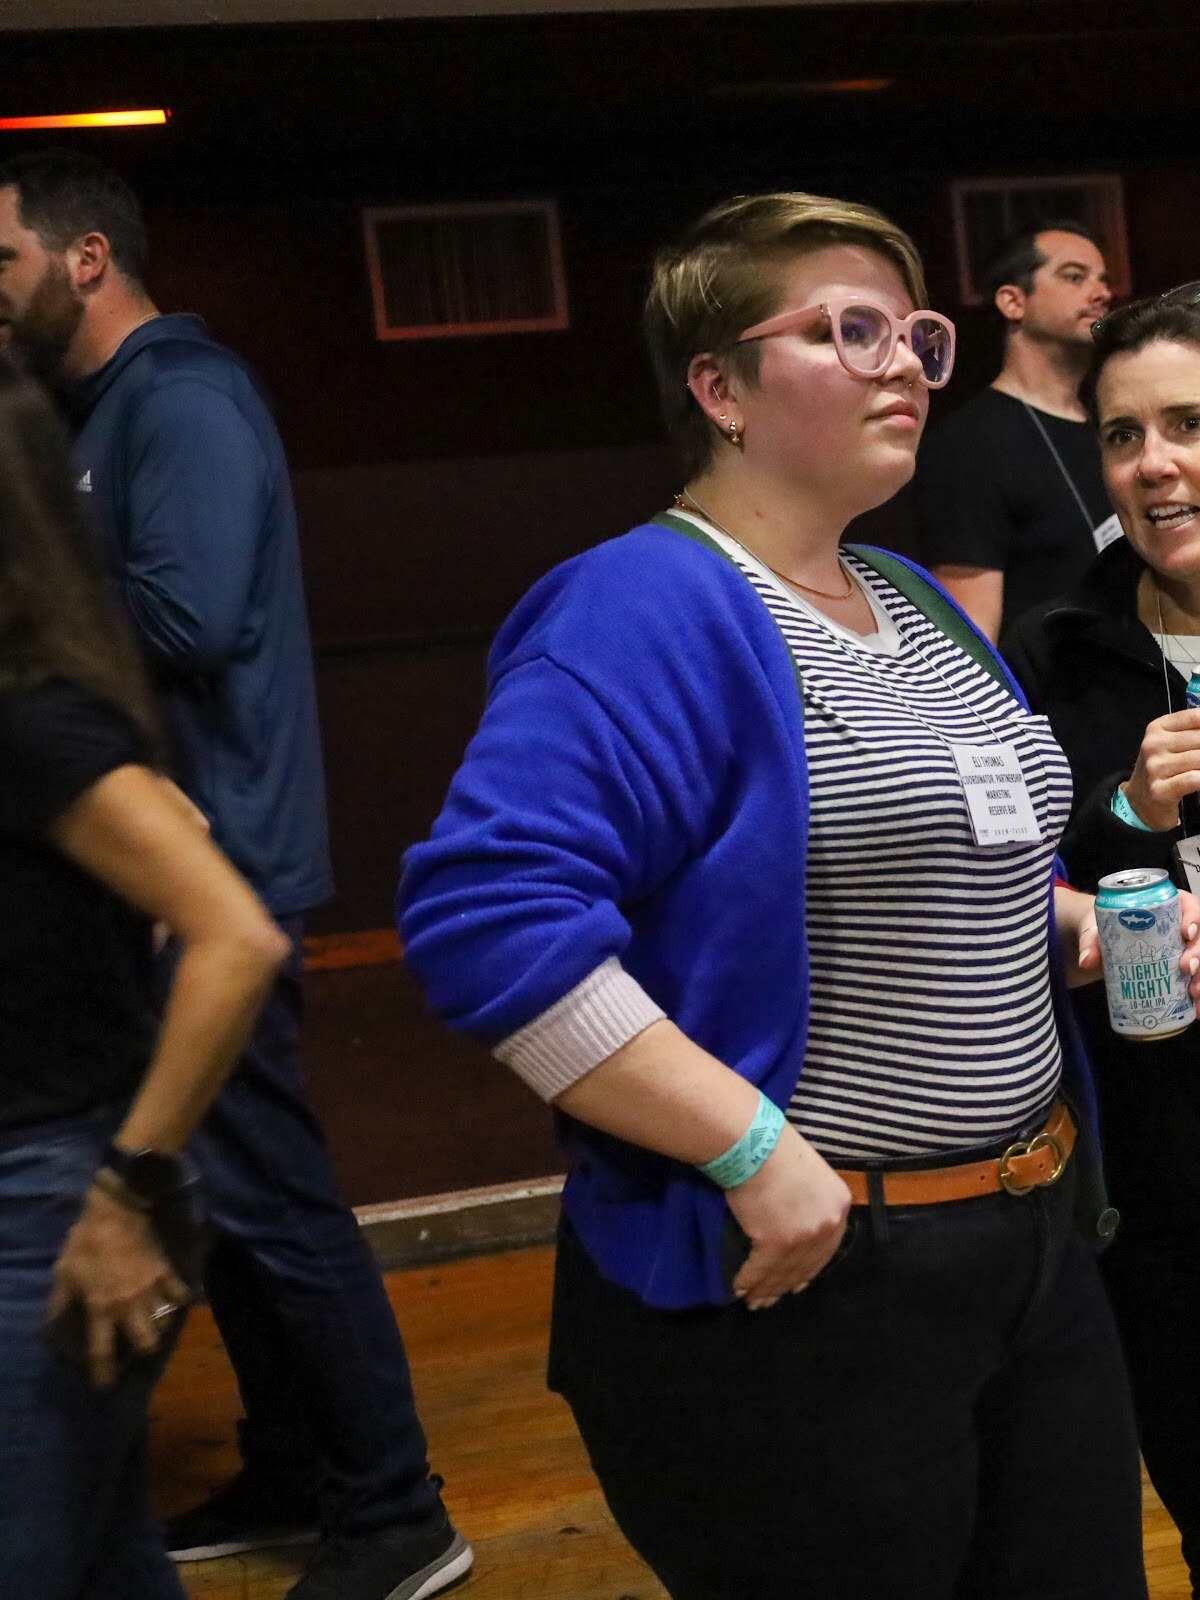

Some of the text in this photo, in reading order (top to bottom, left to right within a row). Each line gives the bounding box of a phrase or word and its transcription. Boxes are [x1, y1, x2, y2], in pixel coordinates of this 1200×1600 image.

[981, 756, 1005, 767] THOMAS
[985, 790, 1012, 800] MARKETING
[988, 805, 1017, 816] RESERVE BAR
[1118, 960, 1169, 981] SLIGHTLY
[1120, 976, 1171, 1000] MIGHTY
[1130, 998, 1166, 1010] LO-CAL IPA
